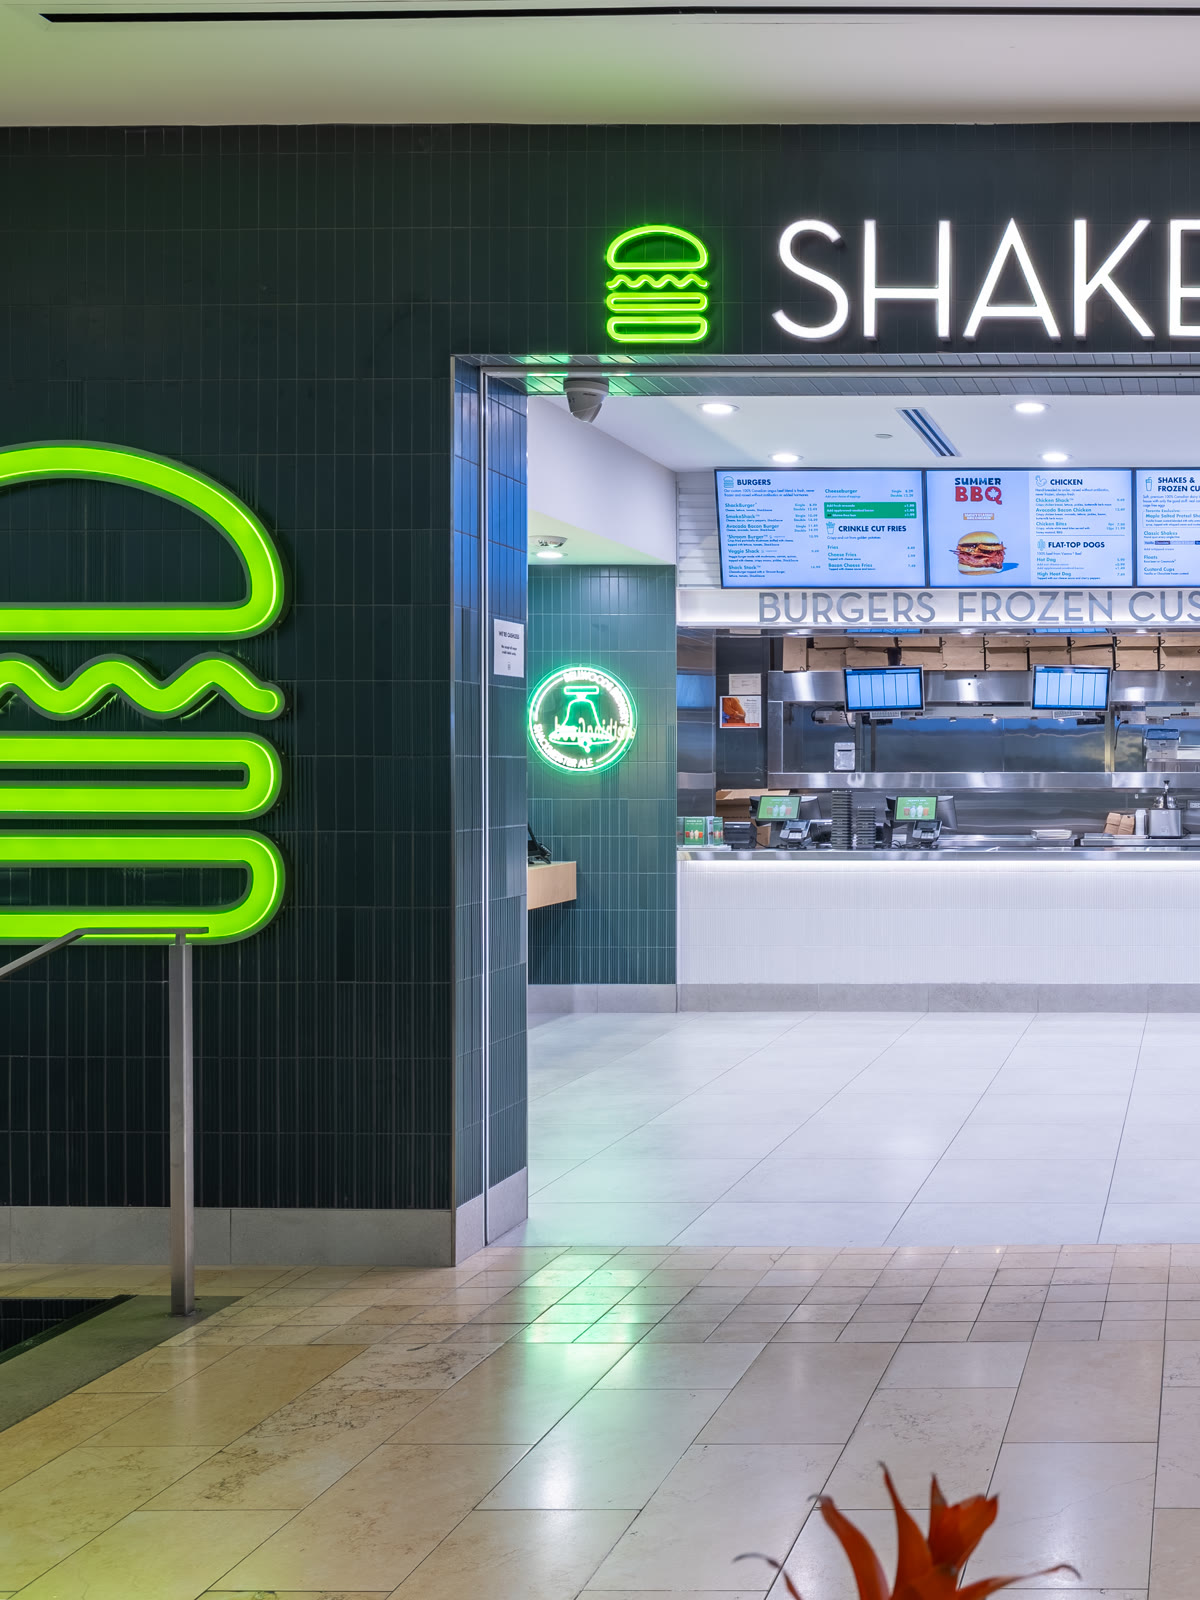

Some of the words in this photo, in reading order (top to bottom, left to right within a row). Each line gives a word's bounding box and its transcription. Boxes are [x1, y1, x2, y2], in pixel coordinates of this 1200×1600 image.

[955, 486, 1002, 505] BBQ
[758, 591, 936, 623] BURGERS
[958, 591, 1113, 623] FROZEN
